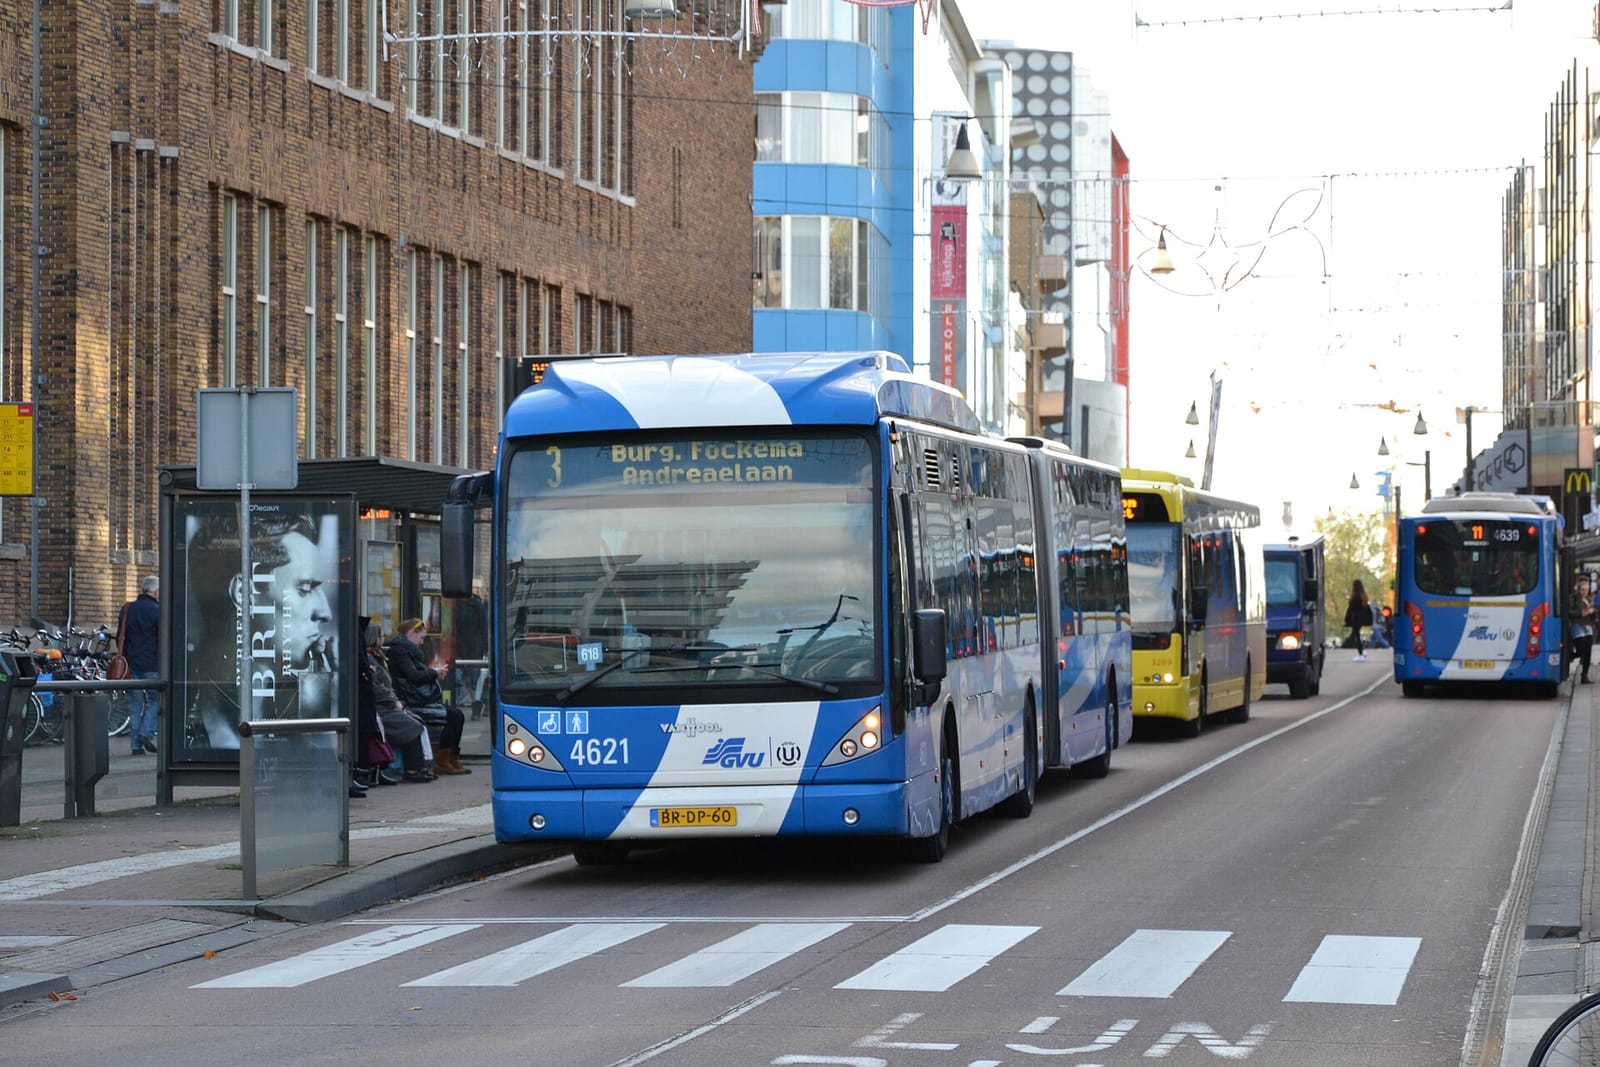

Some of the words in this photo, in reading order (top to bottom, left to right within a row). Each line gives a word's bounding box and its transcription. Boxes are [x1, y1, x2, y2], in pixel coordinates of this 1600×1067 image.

[611, 444, 681, 462] Burg.
[691, 440, 803, 460] Fockema
[546, 446, 561, 488] 3
[623, 463, 793, 485] Andreaelaan
[1471, 524, 1484, 540] 11
[252, 562, 276, 703] BRIT
[282, 589, 292, 677] RHYTHM
[581, 647, 600, 661] 618
[570, 738, 629, 766] 4621
[719, 752, 766, 768] GVU
[660, 809, 732, 825] BR-DP-60
